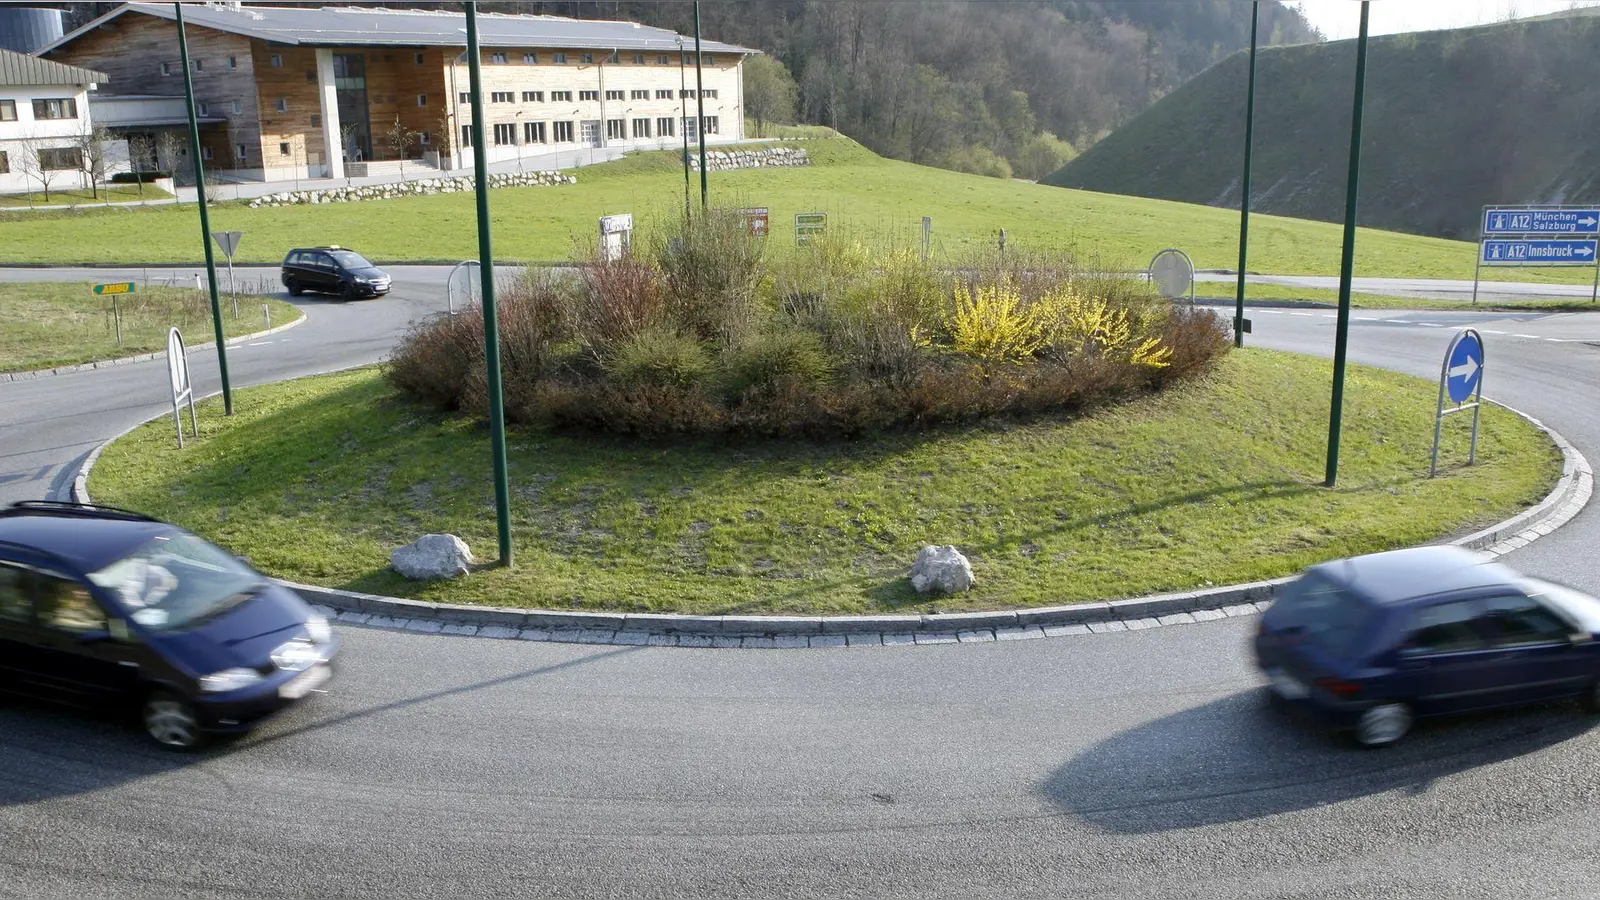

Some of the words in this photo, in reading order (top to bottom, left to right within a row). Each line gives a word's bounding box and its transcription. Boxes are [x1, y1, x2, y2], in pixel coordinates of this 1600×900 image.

[1511, 215, 1530, 228] A12
[1534, 212, 1577, 221] München
[1533, 221, 1576, 232] Salzburg
[1507, 245, 1526, 258] A12
[1528, 244, 1573, 257] Innsbruck
